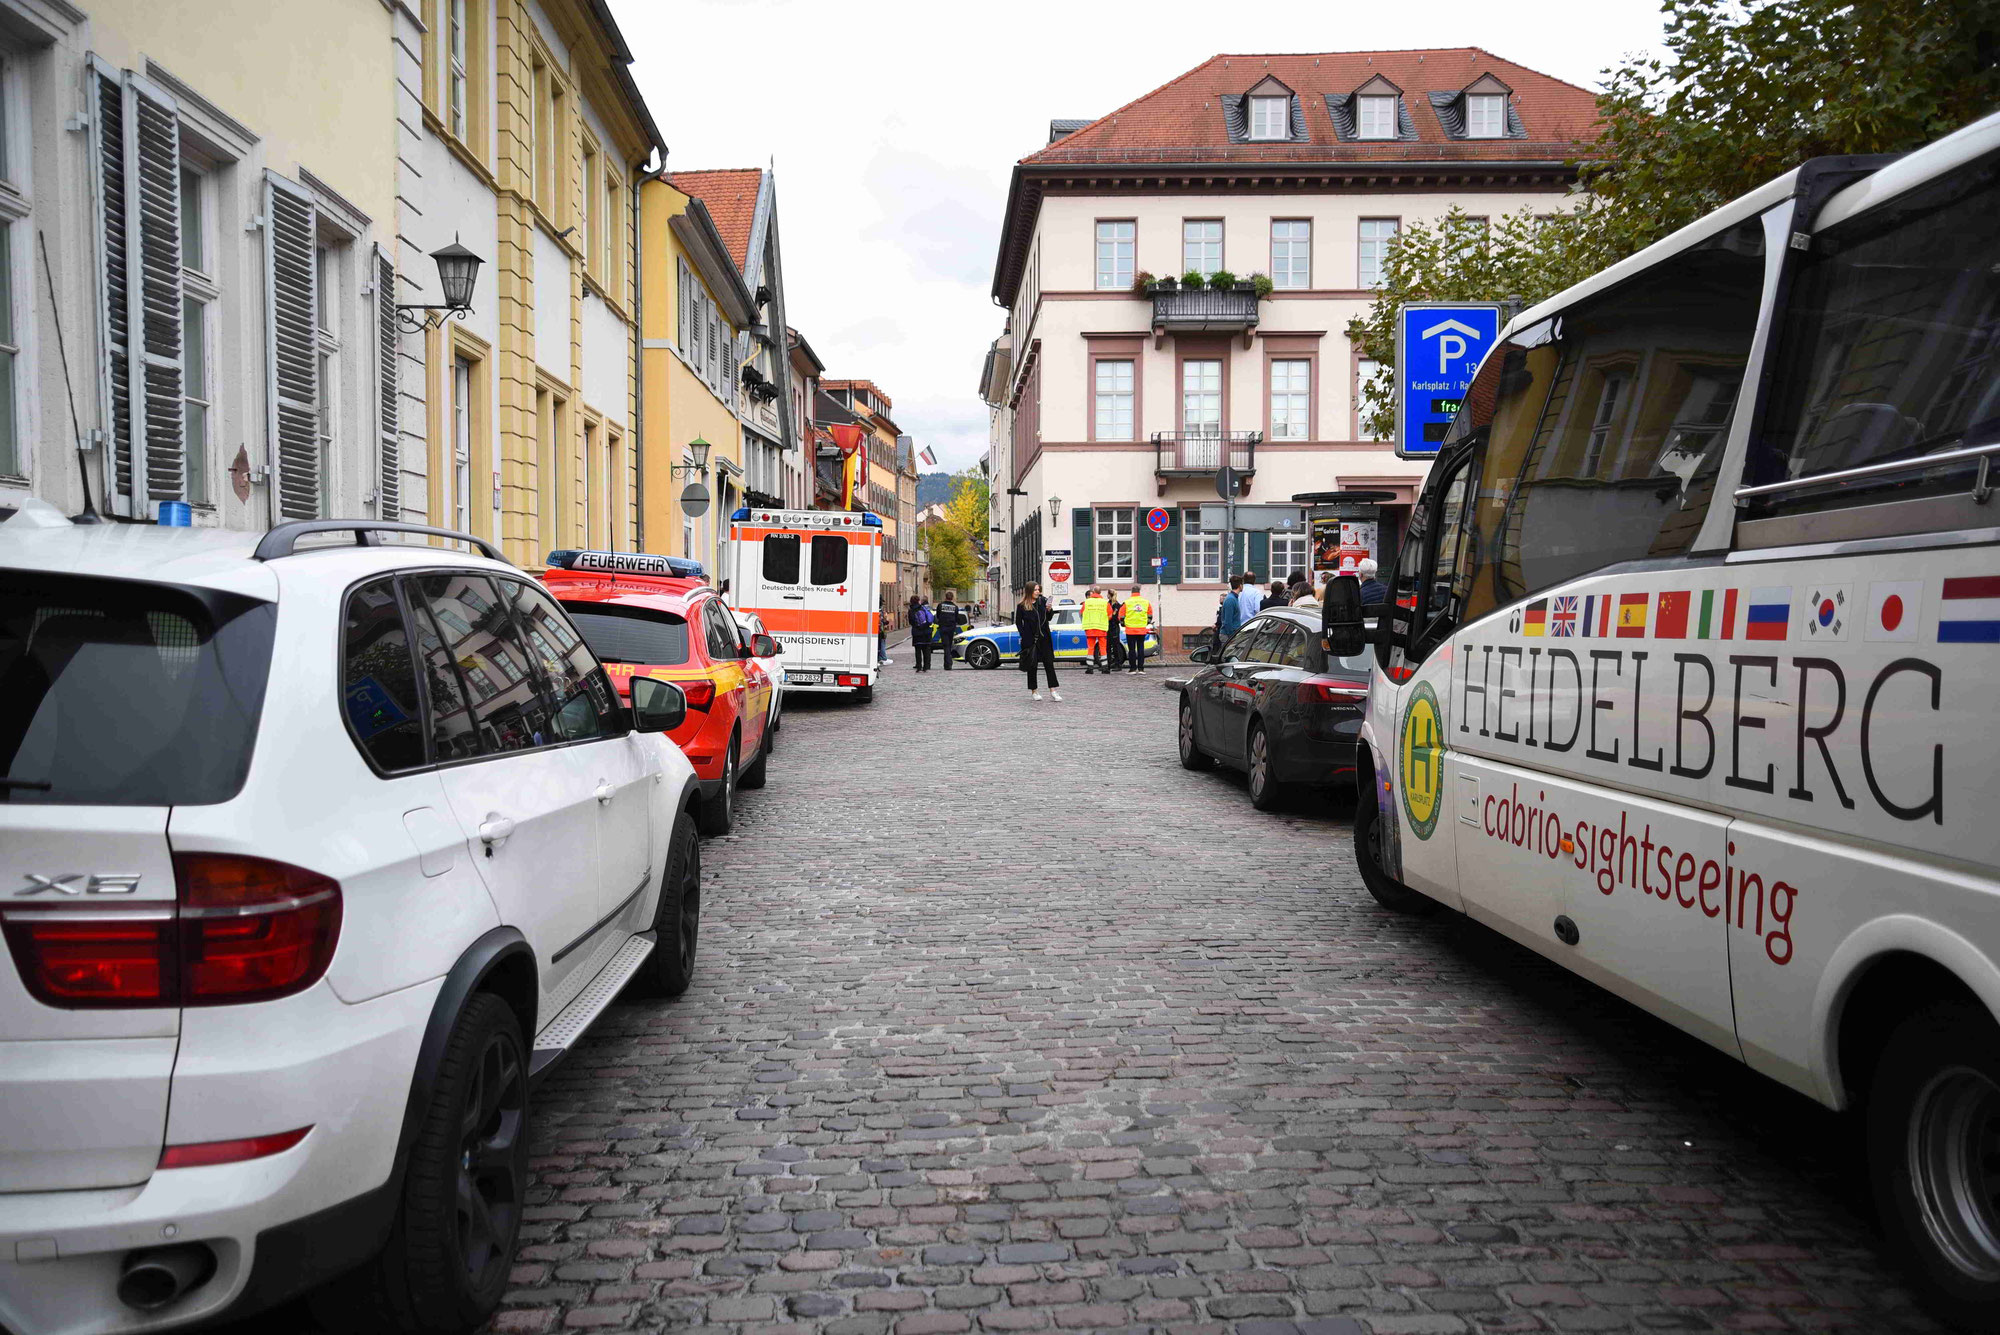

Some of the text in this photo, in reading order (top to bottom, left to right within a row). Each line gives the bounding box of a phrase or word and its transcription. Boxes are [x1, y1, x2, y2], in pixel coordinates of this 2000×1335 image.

[1440, 335, 1466, 374] P
[1465, 363, 1477, 374] 13
[1412, 380, 1450, 392] Karlsplatz
[1460, 381, 1470, 390] Ra
[581, 554, 665, 572] FEUERWEHR
[773, 636, 845, 645] TTUNGSDIENST
[1460, 644, 1944, 826] HEIDELBERG
[1410, 716, 1431, 793] H
[14, 872, 142, 896] X5
[1484, 782, 1798, 966] cabrio-sightseeing
